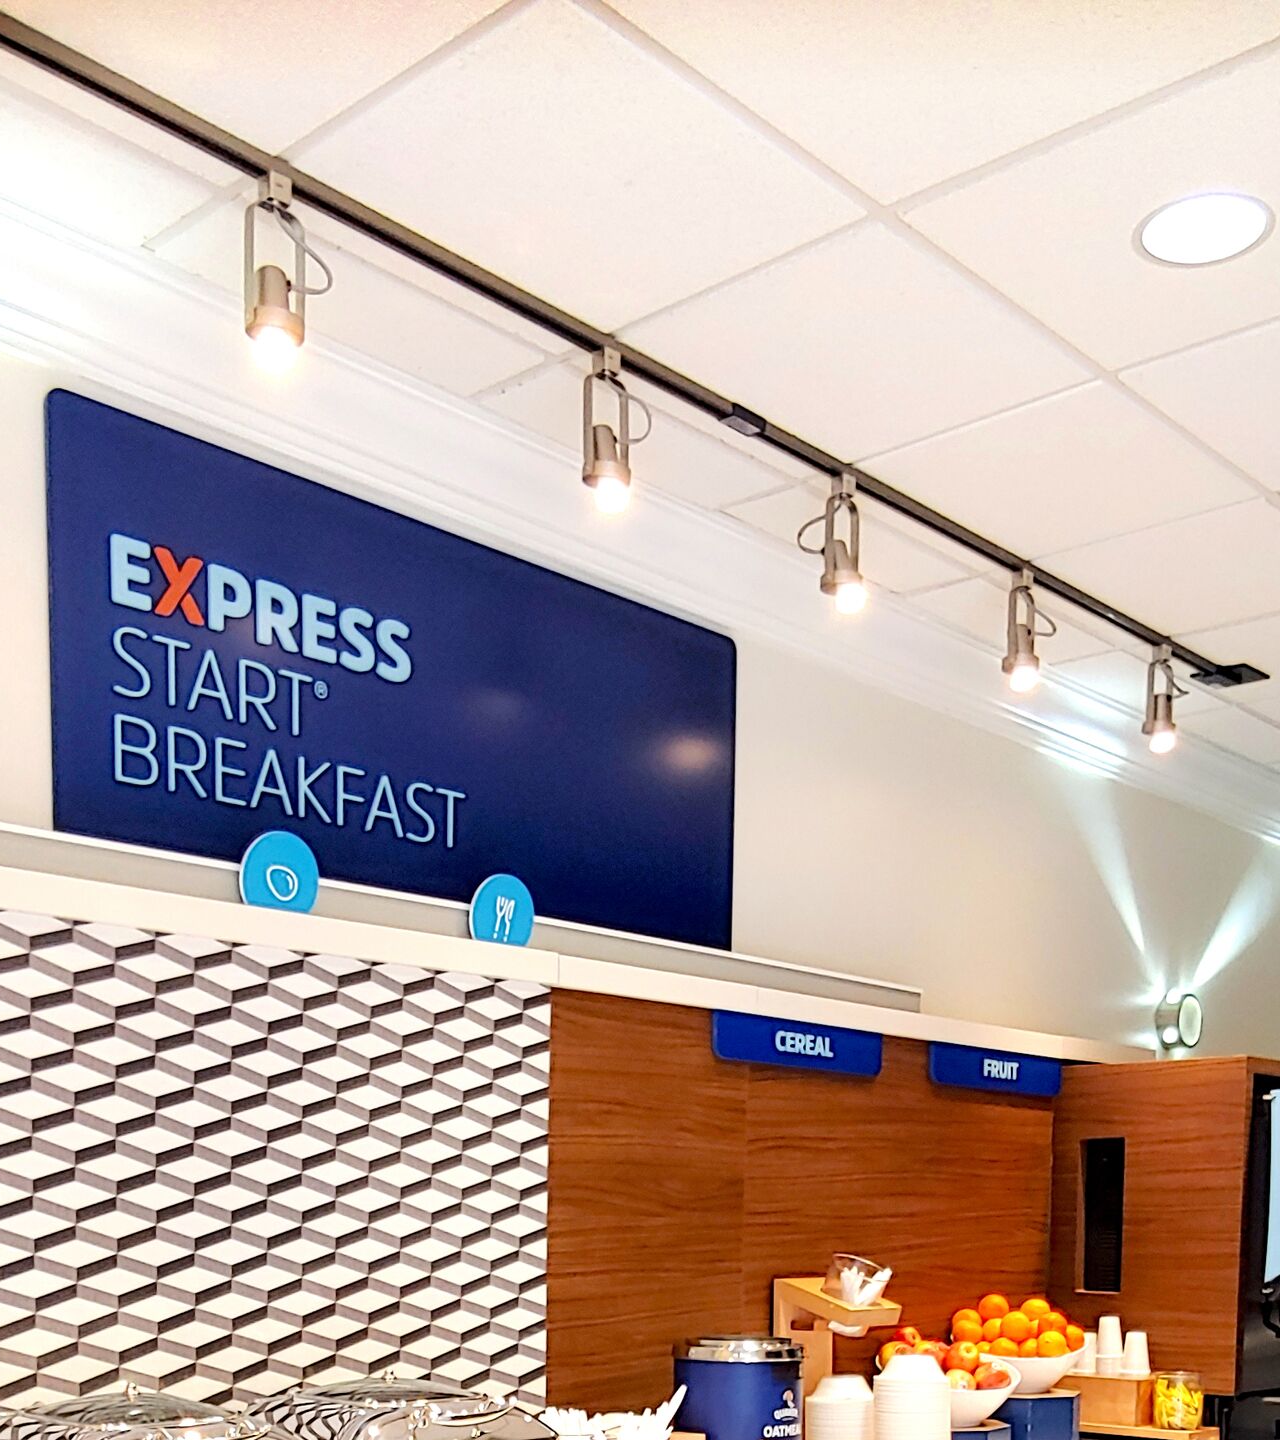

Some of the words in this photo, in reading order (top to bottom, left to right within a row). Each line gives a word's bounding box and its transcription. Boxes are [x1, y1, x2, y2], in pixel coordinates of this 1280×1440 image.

[109, 533, 412, 683] EXPRESS
[113, 713, 467, 849] BREAKFAST
[775, 1030, 834, 1058] CEREAL
[982, 1058, 1019, 1081] FRUIT
